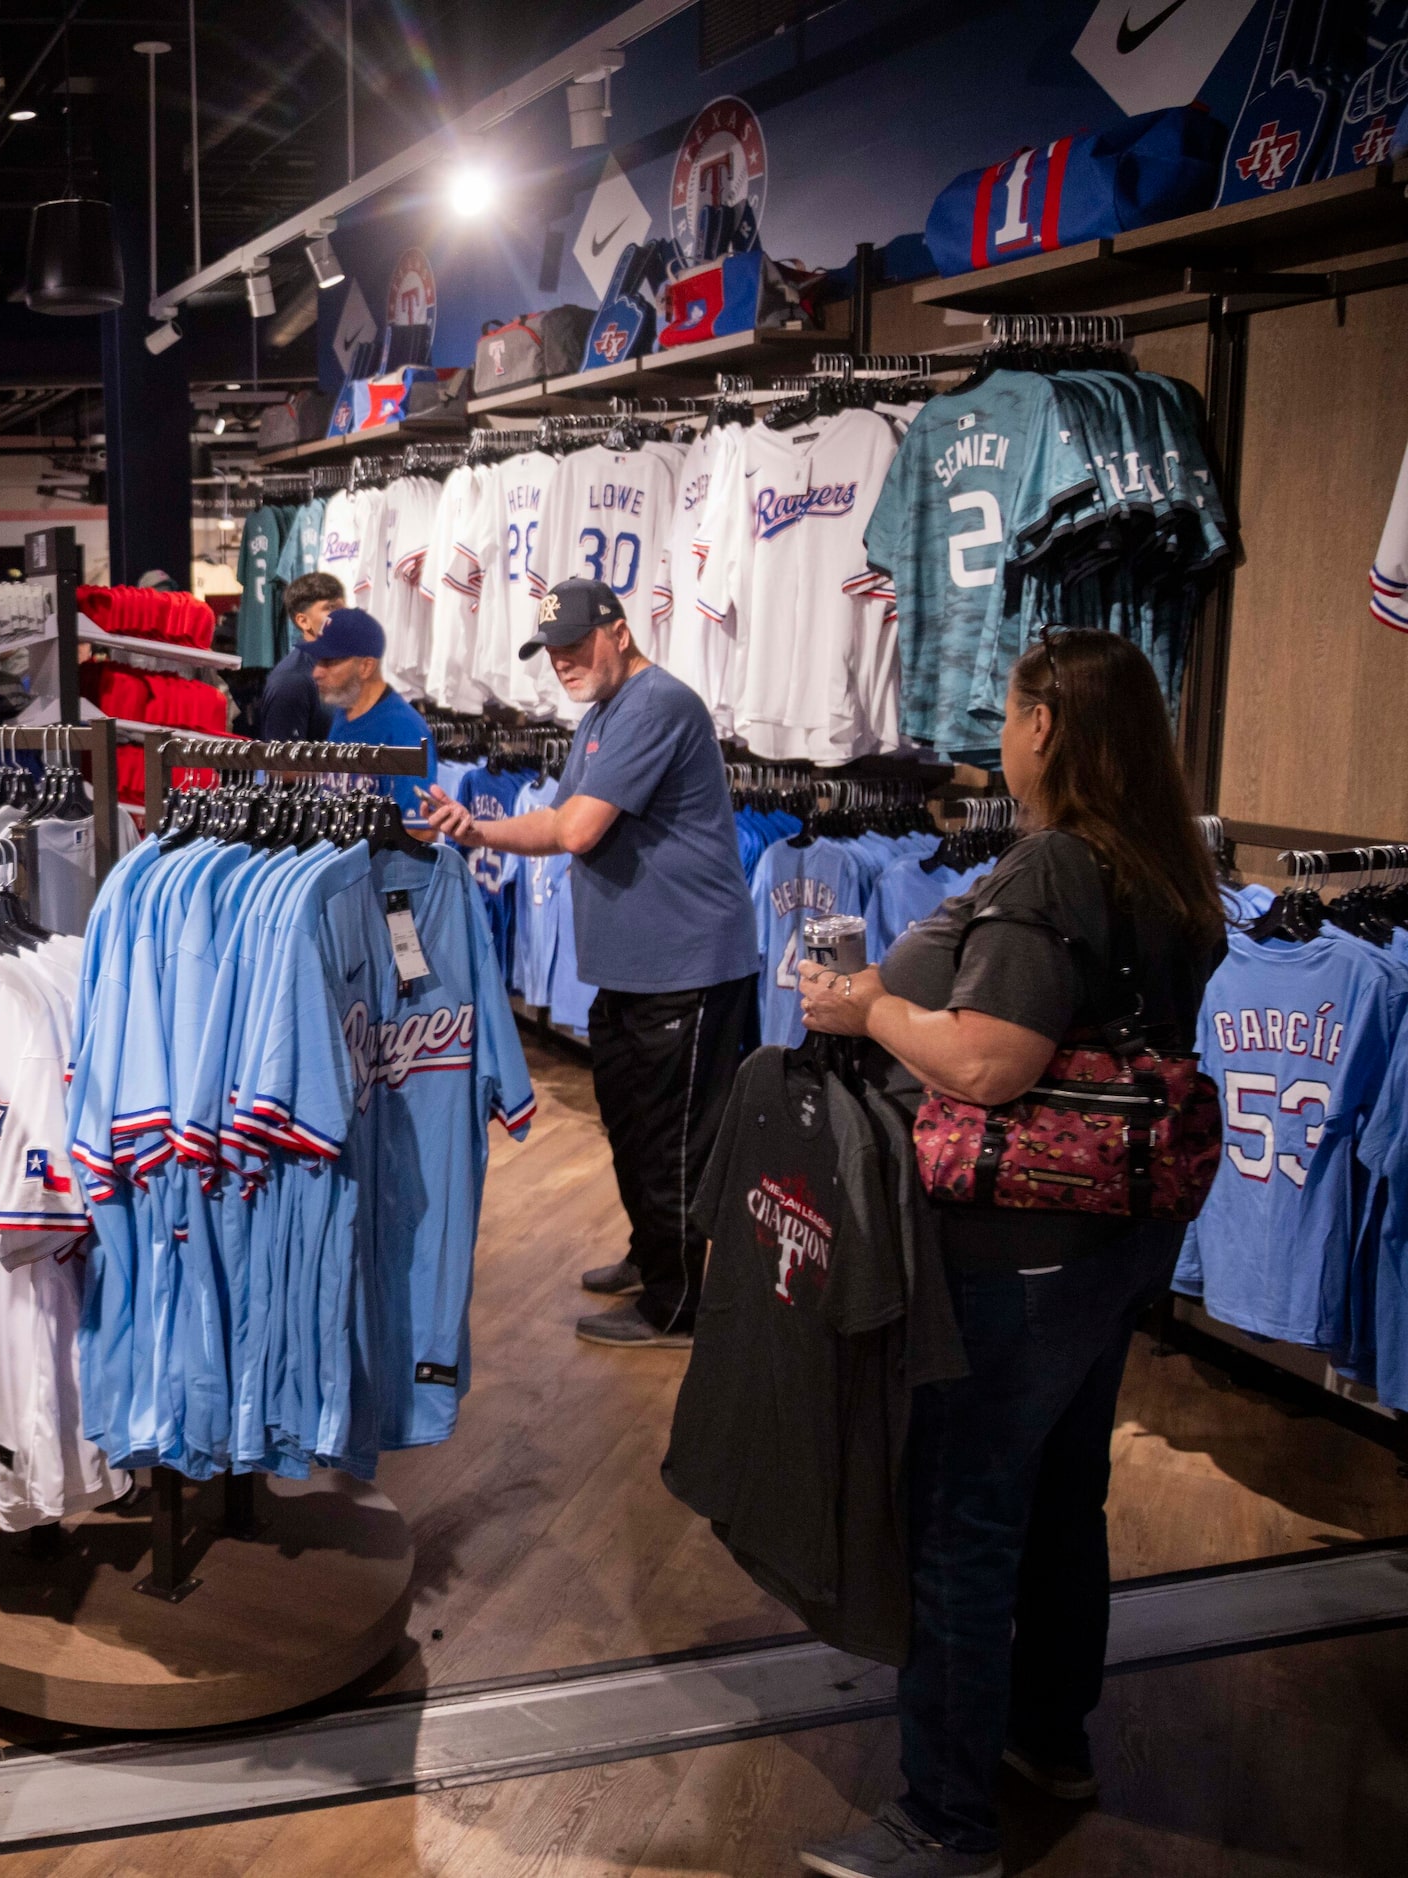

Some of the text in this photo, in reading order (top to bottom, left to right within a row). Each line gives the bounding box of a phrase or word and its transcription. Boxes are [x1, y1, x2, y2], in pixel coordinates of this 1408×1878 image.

[488, 340, 507, 377] T
[934, 433, 1010, 488] SEMIEN
[507, 485, 541, 513] HEIM
[589, 484, 645, 518] LOWE
[755, 482, 860, 540] Rangers
[579, 528, 642, 598] 30
[948, 490, 1003, 588] 2
[771, 878, 837, 918] HEANEY
[1224, 1069, 1332, 1190] 53
[775, 1236, 805, 1304] T
